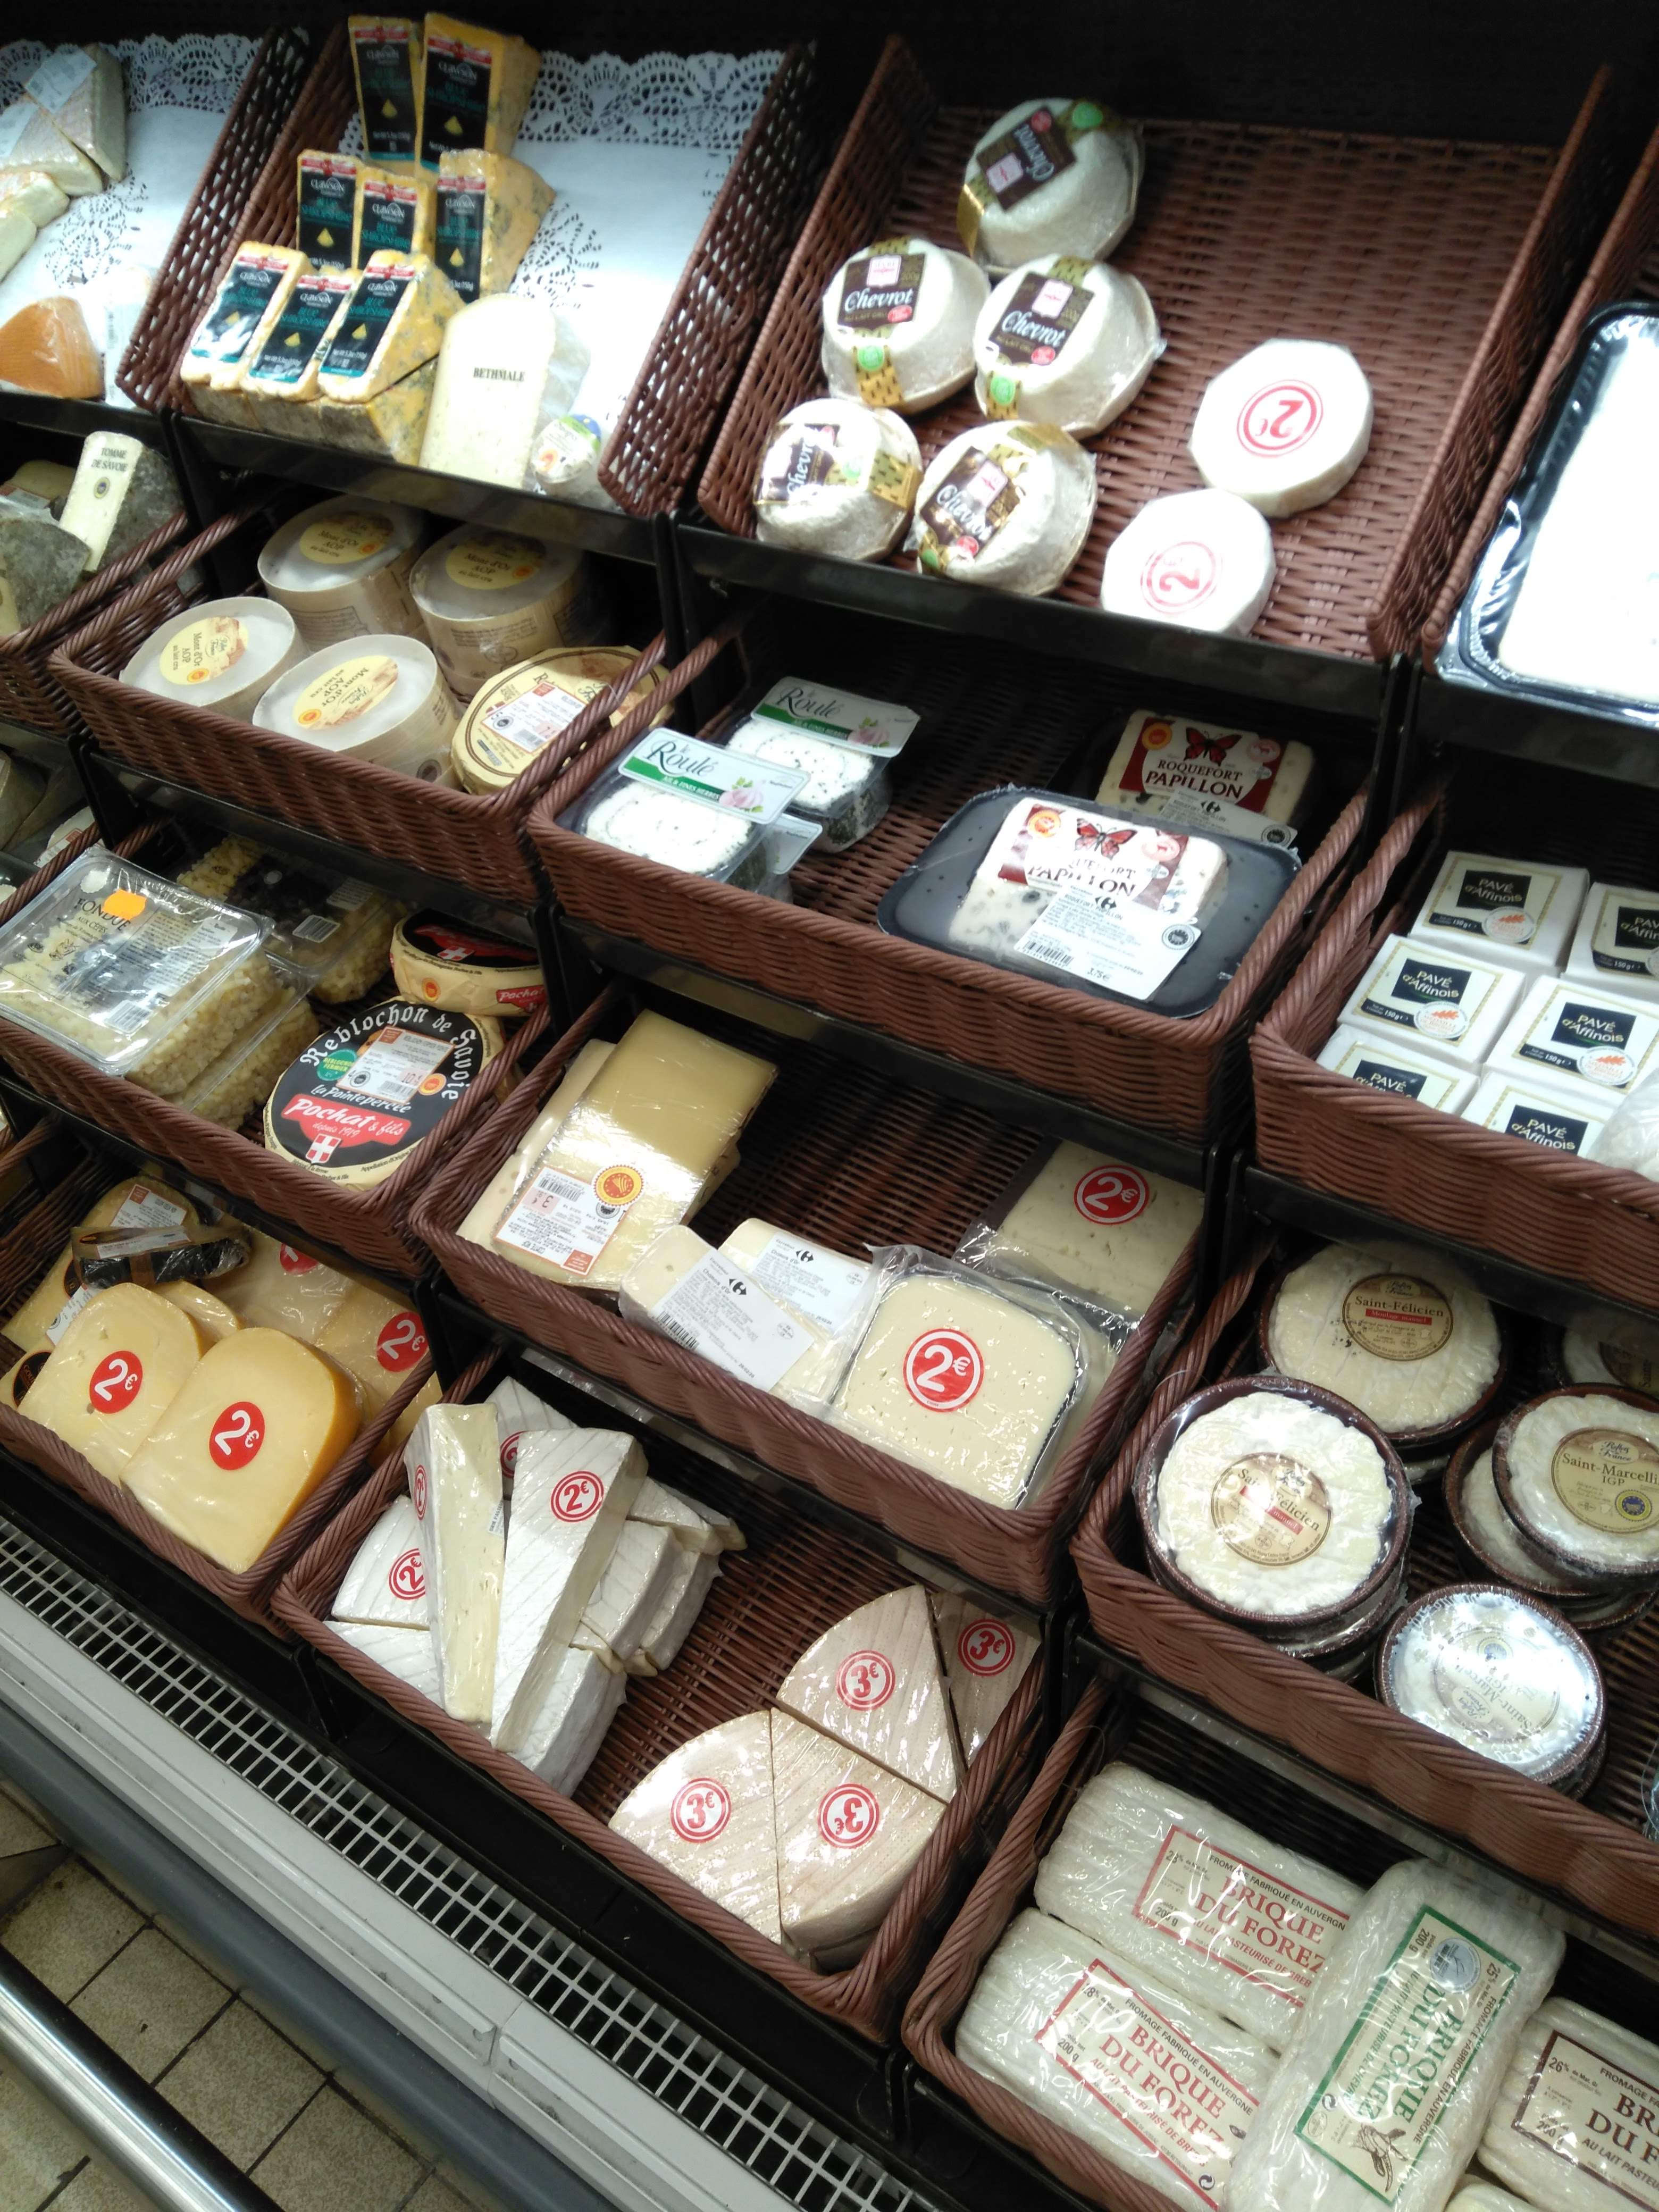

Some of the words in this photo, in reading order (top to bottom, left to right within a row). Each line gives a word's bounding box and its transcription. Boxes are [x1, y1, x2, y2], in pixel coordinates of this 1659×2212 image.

[844, 288, 913, 313] Chevrot
[1002, 311, 1066, 348] Chevrot
[1255, 399, 1304, 438] 2€
[182, 648, 191, 663] AOP
[194, 632, 202, 651] Mont
[194, 651, 203, 666] d'Or
[323, 677, 345, 697] AOP
[342, 667, 370, 688] Mont
[320, 689, 343, 707] d'Or
[776, 686, 845, 718] Roulé
[644, 740, 718, 777] Roulé
[1157, 759, 1243, 782] ROQUEFORT
[696, 786, 720, 799] HERBES
[1145, 771, 1244, 800] PAPILLON
[1465, 884, 1523, 903] d'Affinois
[1479, 877, 1514, 894] PAVÉ
[1403, 974, 1459, 998] d'Affinois
[1417, 970, 1453, 988] PAVÉ
[299, 1003, 430, 1067] Reblochon
[431, 1013, 453, 1033] de
[1562, 1018, 1624, 1043] d'Affinois
[1577, 1014, 1616, 1033] PAVÉ
[441, 1028, 477, 1101] Savoie
[1370, 1072, 1406, 1092] PAVÉ
[311, 1083, 326, 1096] La
[325, 1086, 413, 1114] Pointepercée
[284, 1098, 375, 1128] Pochat
[368, 1121, 378, 1131] &
[375, 1120, 405, 1137] fils
[312, 1121, 337, 1135] depuis
[338, 1126, 362, 1138] 1919
[1527, 1118, 1567, 1139] PAVÉ
[542, 1195, 554, 1209] 3
[1084, 1176, 1138, 1211] 2€
[1355, 1296, 1444, 1317] Saint-Félicien
[1370, 1310, 1400, 1320] Moulage
[382, 1319, 425, 1360] 2€
[94, 1358, 138, 1401] 2€
[916, 1344, 971, 1393] 2€
[214, 1409, 259, 1456] 2€
[1603, 1441, 1630, 1453] Reflets
[1599, 1448, 1632, 1462] France
[416, 1476, 424, 1508] 2€
[1602, 1476, 1626, 1486] IGP
[563, 1480, 590, 1512] 2€
[1273, 1510, 1298, 1529] manuel
[399, 1556, 424, 1590] 2€
[970, 1630, 1006, 1661] 3€
[851, 1662, 879, 1698] 3€
[686, 1791, 715, 1830] 3€
[834, 1797, 864, 1835] 3€
[1250, 1875, 1292, 1903] FABRIQUÉ
[1291, 1897, 1304, 1909] EN
[1219, 1876, 1326, 1945] BRIQUE
[1195, 1892, 1240, 1926] DU
[1241, 1915, 1326, 1974] FOREZ
[1415, 1927, 1431, 1947] 200
[1409, 1945, 1419, 1955] g
[1275, 1963, 1288, 1975] DE
[1410, 1981, 1447, 2033] DU
[1471, 1996, 1498, 2041] FROMAGE
[1057, 2038, 1074, 2056] 200
[1071, 2052, 1080, 2063] g
[1125, 1998, 1162, 2035] FROMAGE
[1162, 2030, 1199, 2067] FABRIQUÉ
[1198, 2064, 1211, 2078] EN
[1209, 2074, 1254, 2116] AUVERGNE
[1548, 2057, 1570, 2073] 26%
[1128, 2024, 1227, 2120] BRIQUE
[1357, 2026, 1421, 2123] FOREZ
[1394, 2010, 1465, 2123] BRIQUE
[1099, 2034, 1144, 2080] DU
[1139, 2070, 1225, 2154] FOREZ
[1440, 2082, 1455, 2104] EN
[1599, 2067, 1648, 2101] FROMAGE
[1164, 2125, 1179, 2141] DE
[1413, 2092, 1445, 2146] AUVERGNE
[1585, 2108, 1639, 2154] DU
[1581, 2137, 1600, 2151] AU
[1599, 2148, 1622, 2166] LAIT
